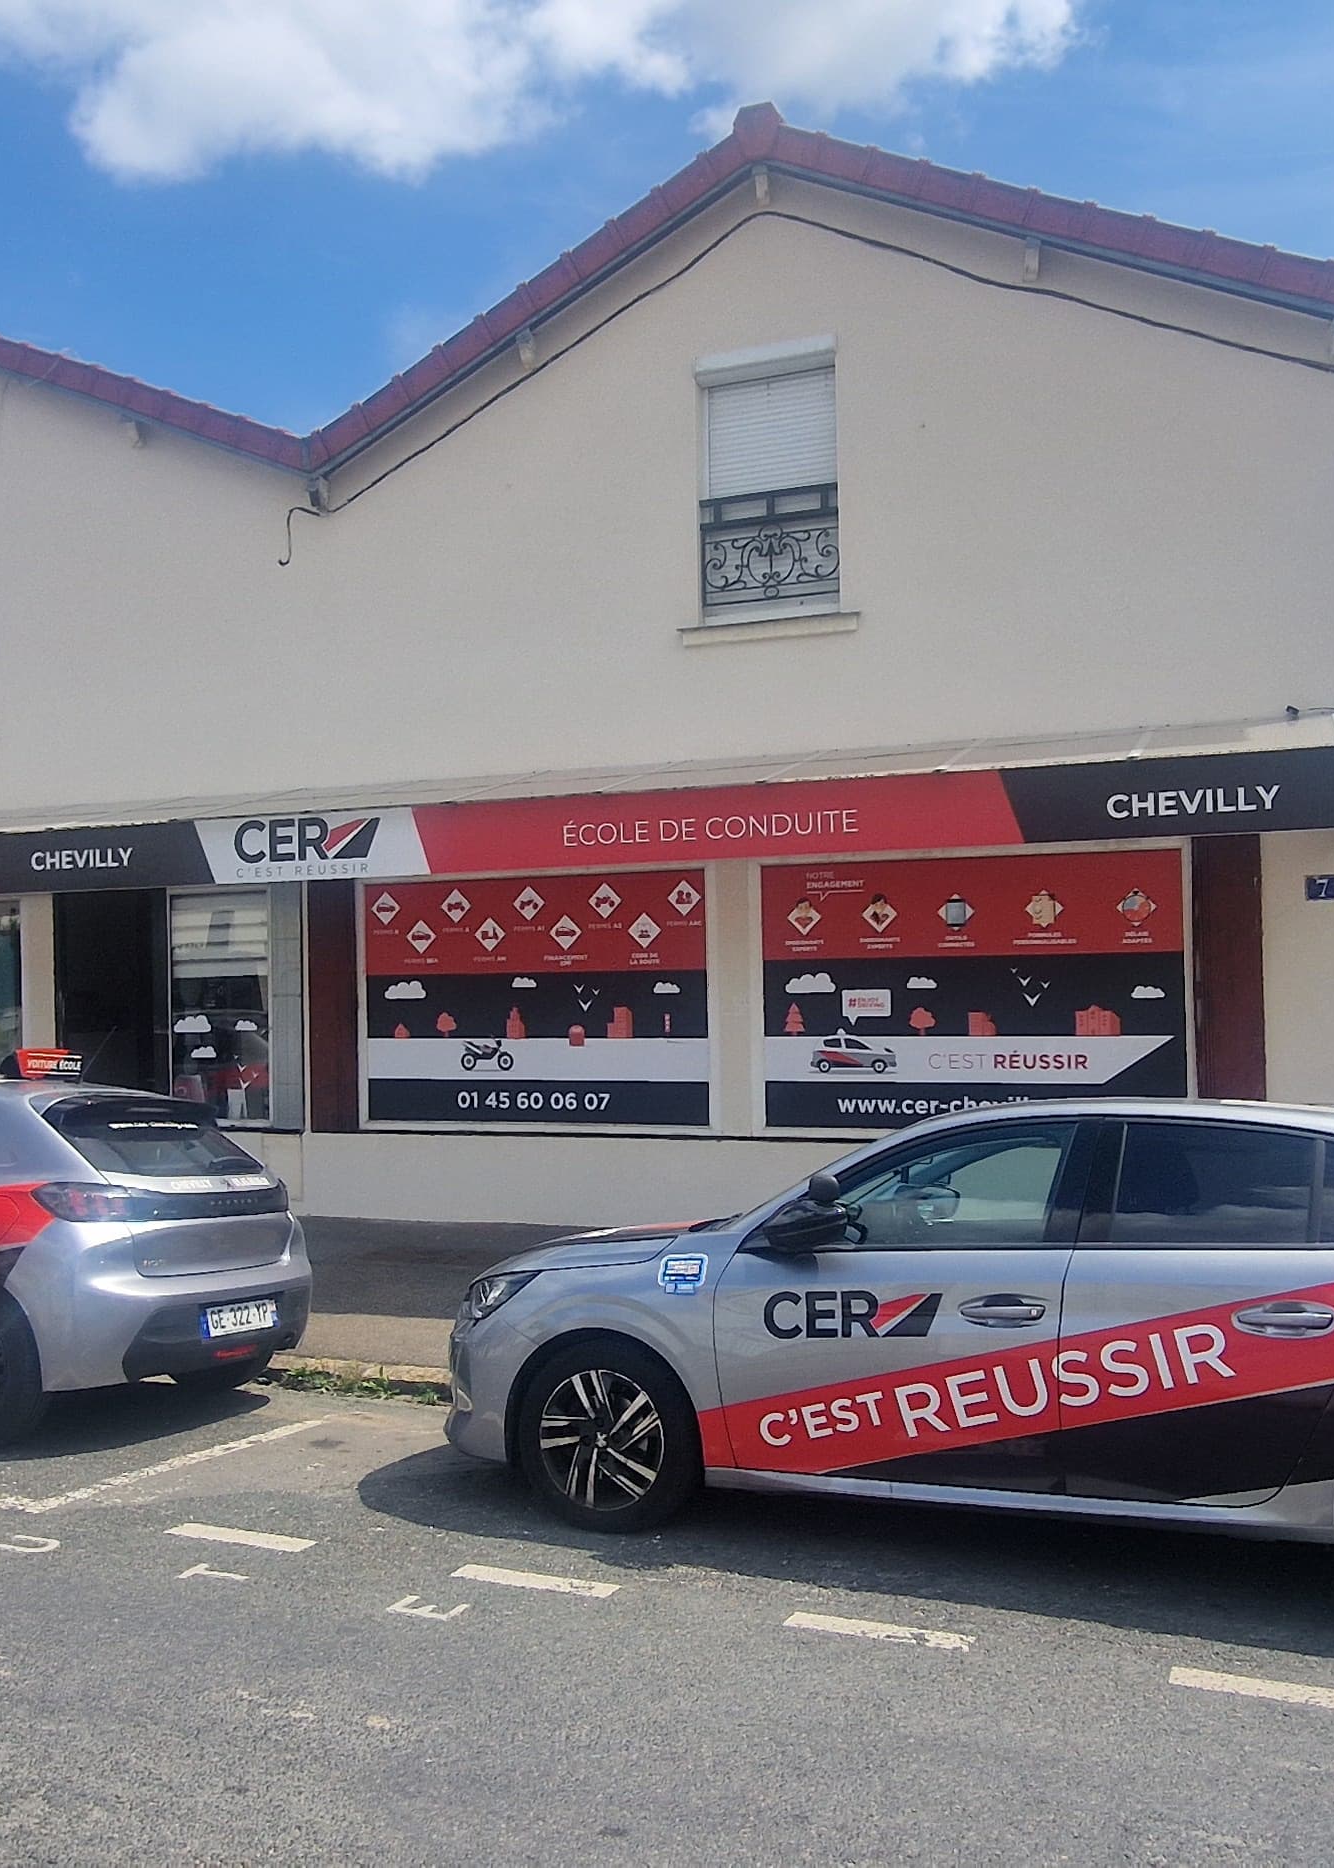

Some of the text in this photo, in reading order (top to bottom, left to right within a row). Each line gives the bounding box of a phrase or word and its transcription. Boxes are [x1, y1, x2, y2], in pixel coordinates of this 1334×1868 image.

[1106, 784, 1280, 819] CHEVILLY
[562, 808, 859, 847] ÉCOLE DE CONDUITE
[234, 817, 330, 864] CER
[30, 847, 133, 871] CHEVILLY
[236, 866, 283, 878] C'EST
[806, 880, 865, 889] ENGAGEMENT
[1317, 878, 1330, 898] 7
[59, 1059, 82, 1071] ÉCOLE
[928, 1050, 1088, 1070] C'EST RÉUSSIR
[457, 1091, 610, 1111] 01 45 60 06 07
[763, 1290, 879, 1340] CER
[759, 1323, 1236, 1447] C'EST REUSSIR
